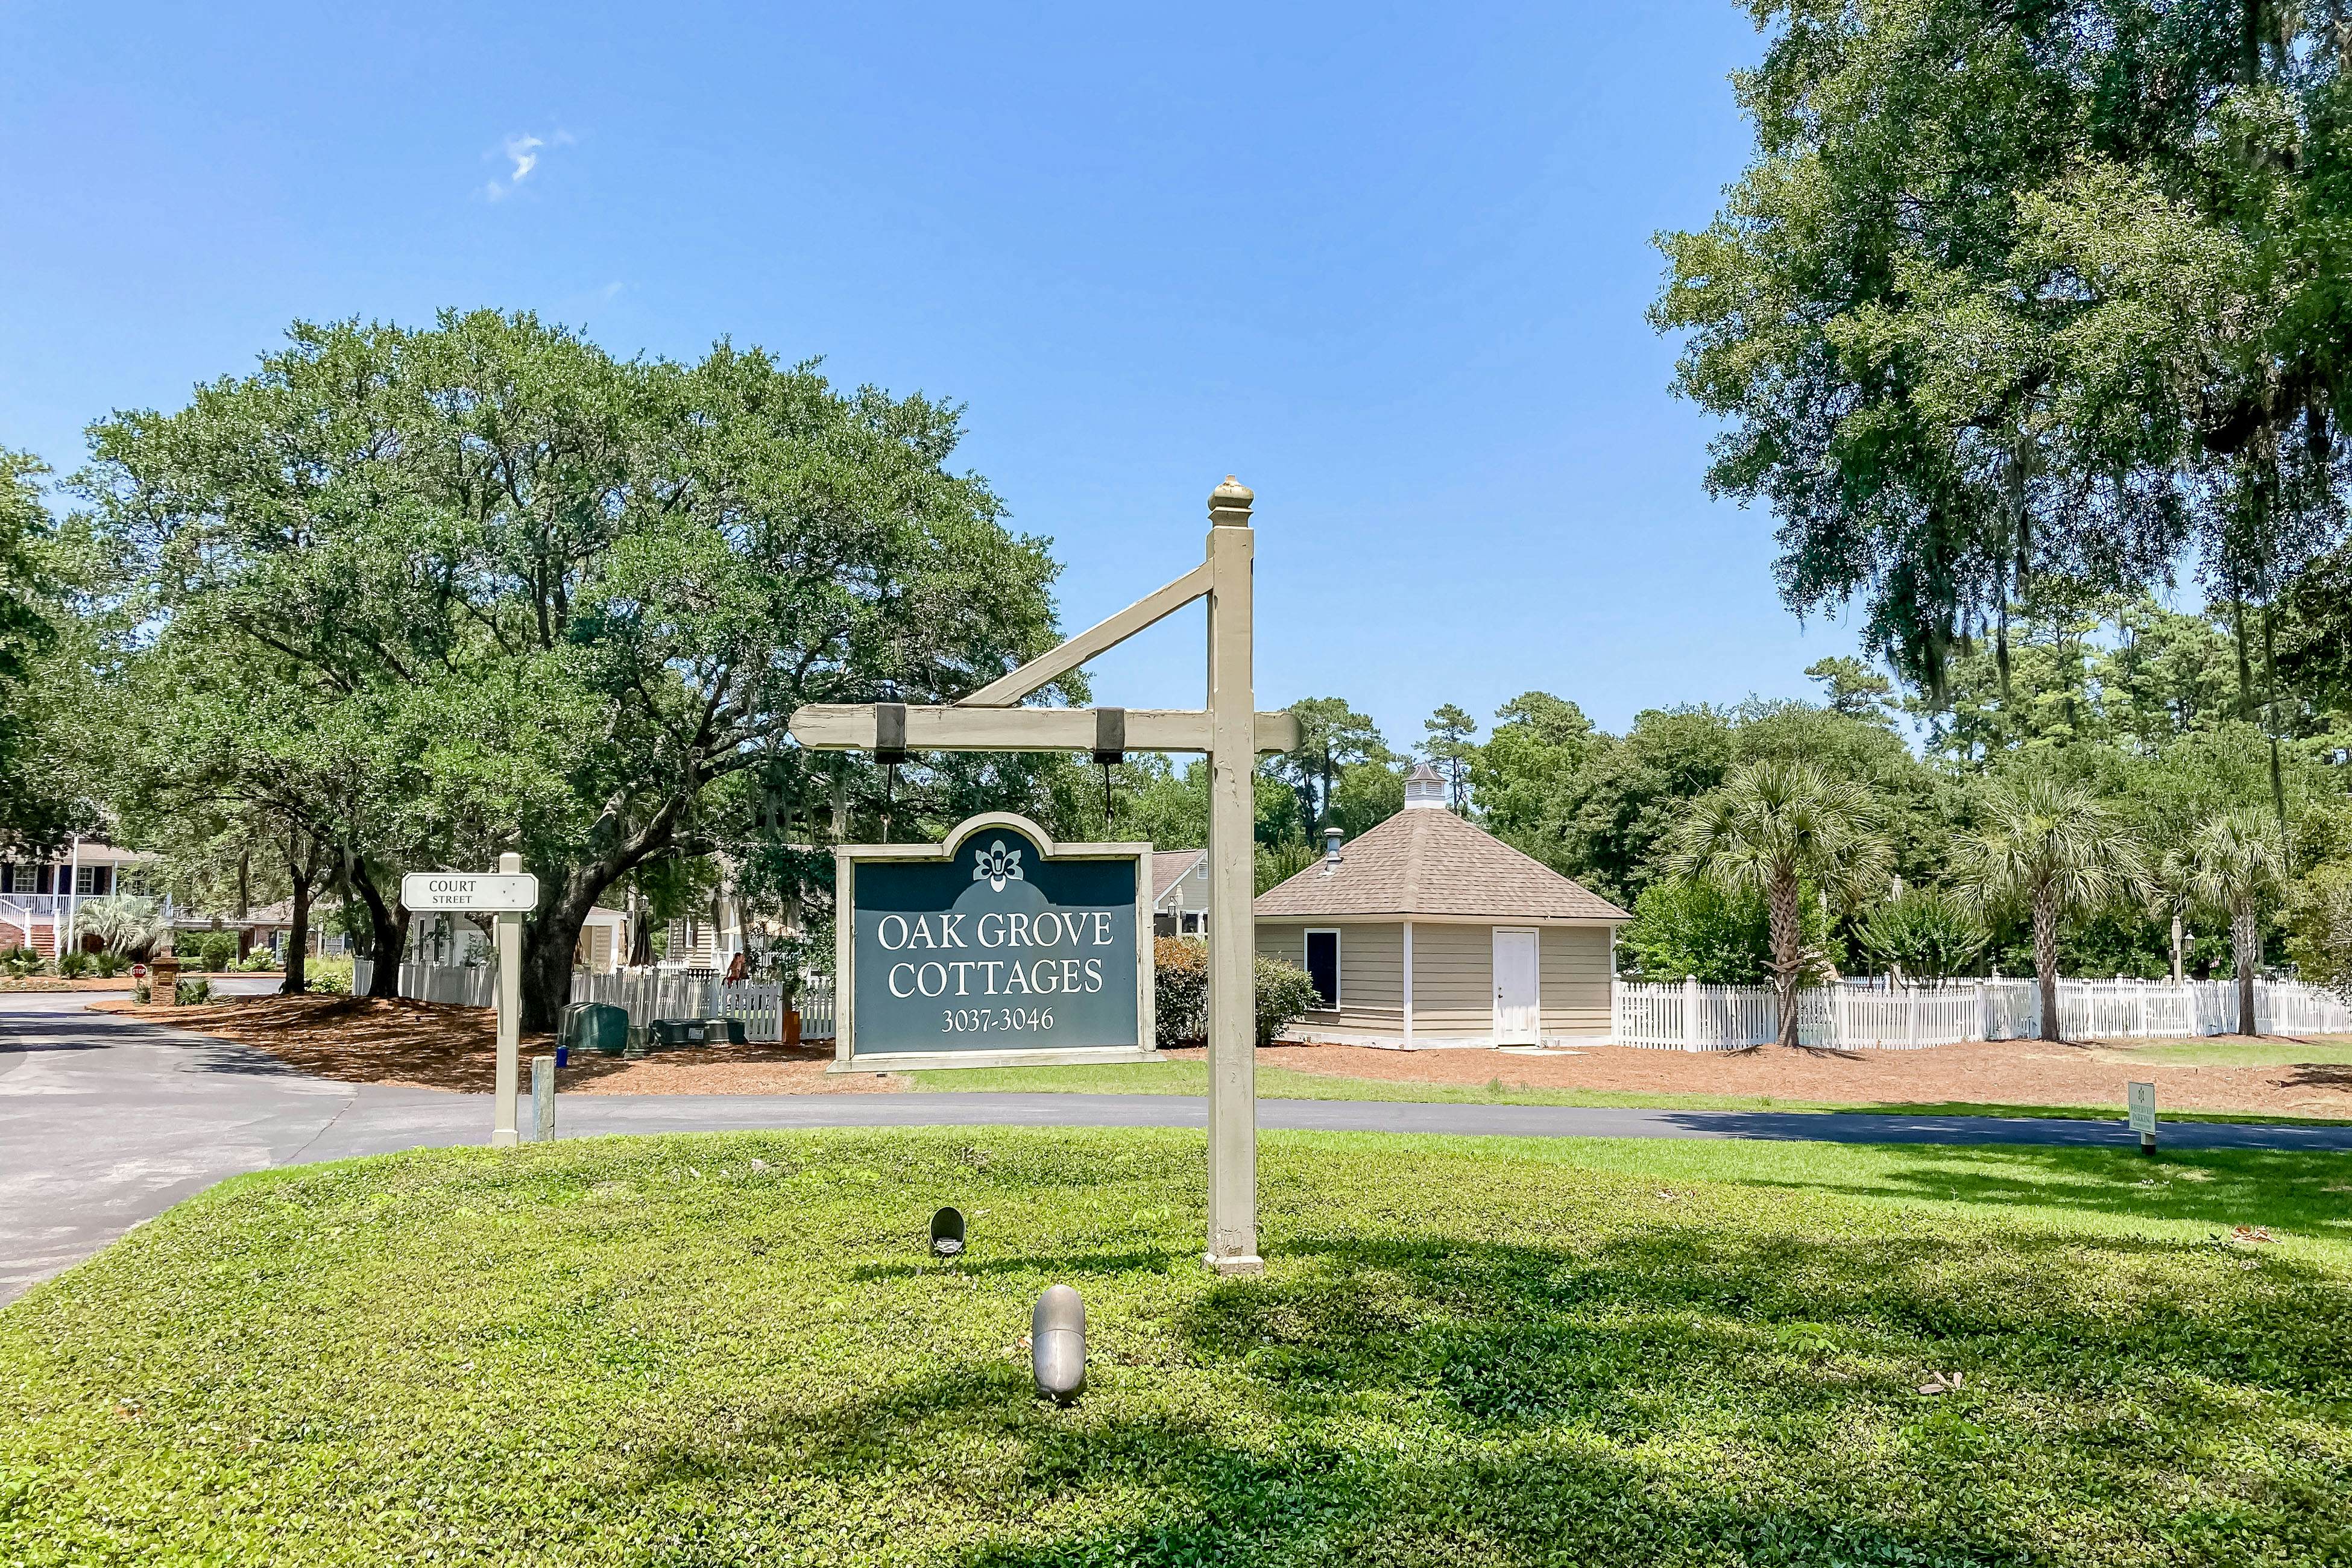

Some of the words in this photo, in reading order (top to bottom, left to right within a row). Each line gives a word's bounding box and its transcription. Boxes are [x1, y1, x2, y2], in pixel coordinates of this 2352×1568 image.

[429, 880, 476, 892] COURT
[432, 895, 472, 904] STREET
[878, 912, 968, 950] OAK
[977, 912, 1114, 948] GROVE
[888, 958, 1103, 998] COTTAGES
[941, 1007, 1055, 1033] 3037-3046
